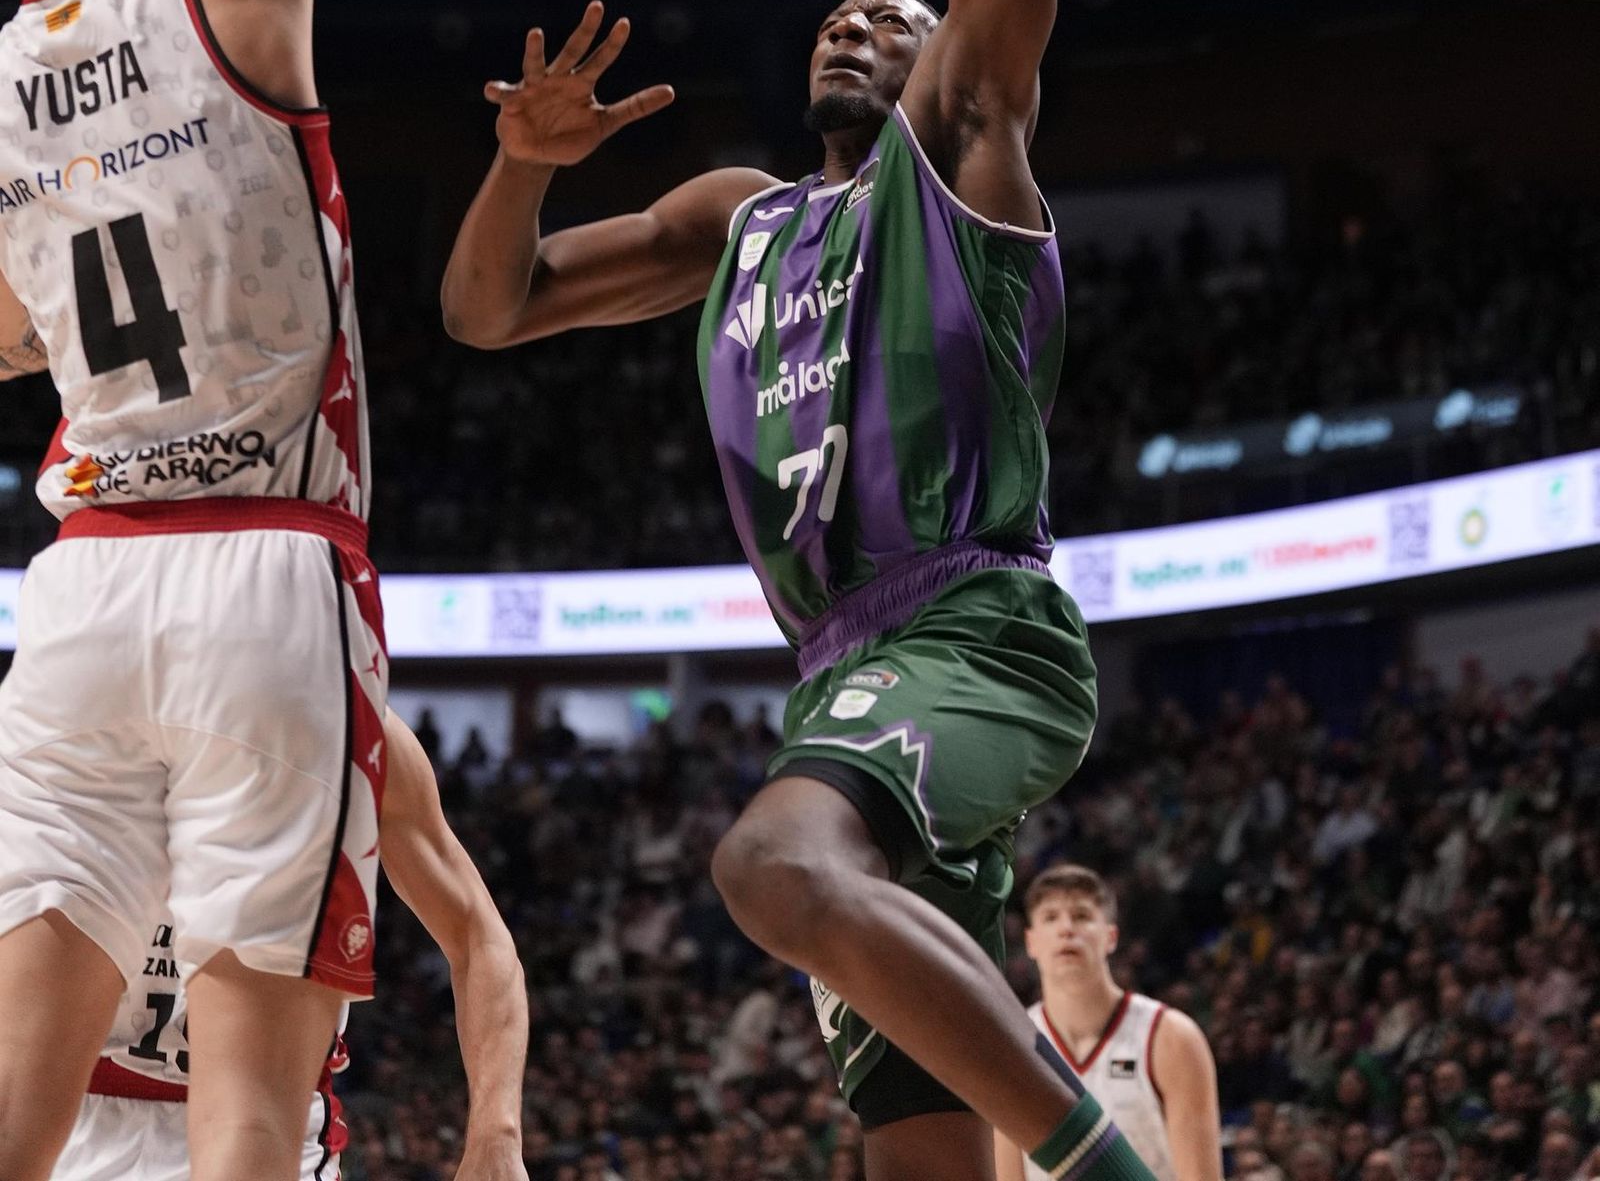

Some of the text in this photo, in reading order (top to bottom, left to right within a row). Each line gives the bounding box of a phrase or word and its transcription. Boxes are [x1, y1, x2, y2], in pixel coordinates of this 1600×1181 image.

[15, 40, 149, 131] YUSTA
[0, 119, 209, 214] AIR HORIZONT
[71, 211, 193, 405] 4
[756, 337, 851, 417] málag
[777, 423, 849, 541] 77
